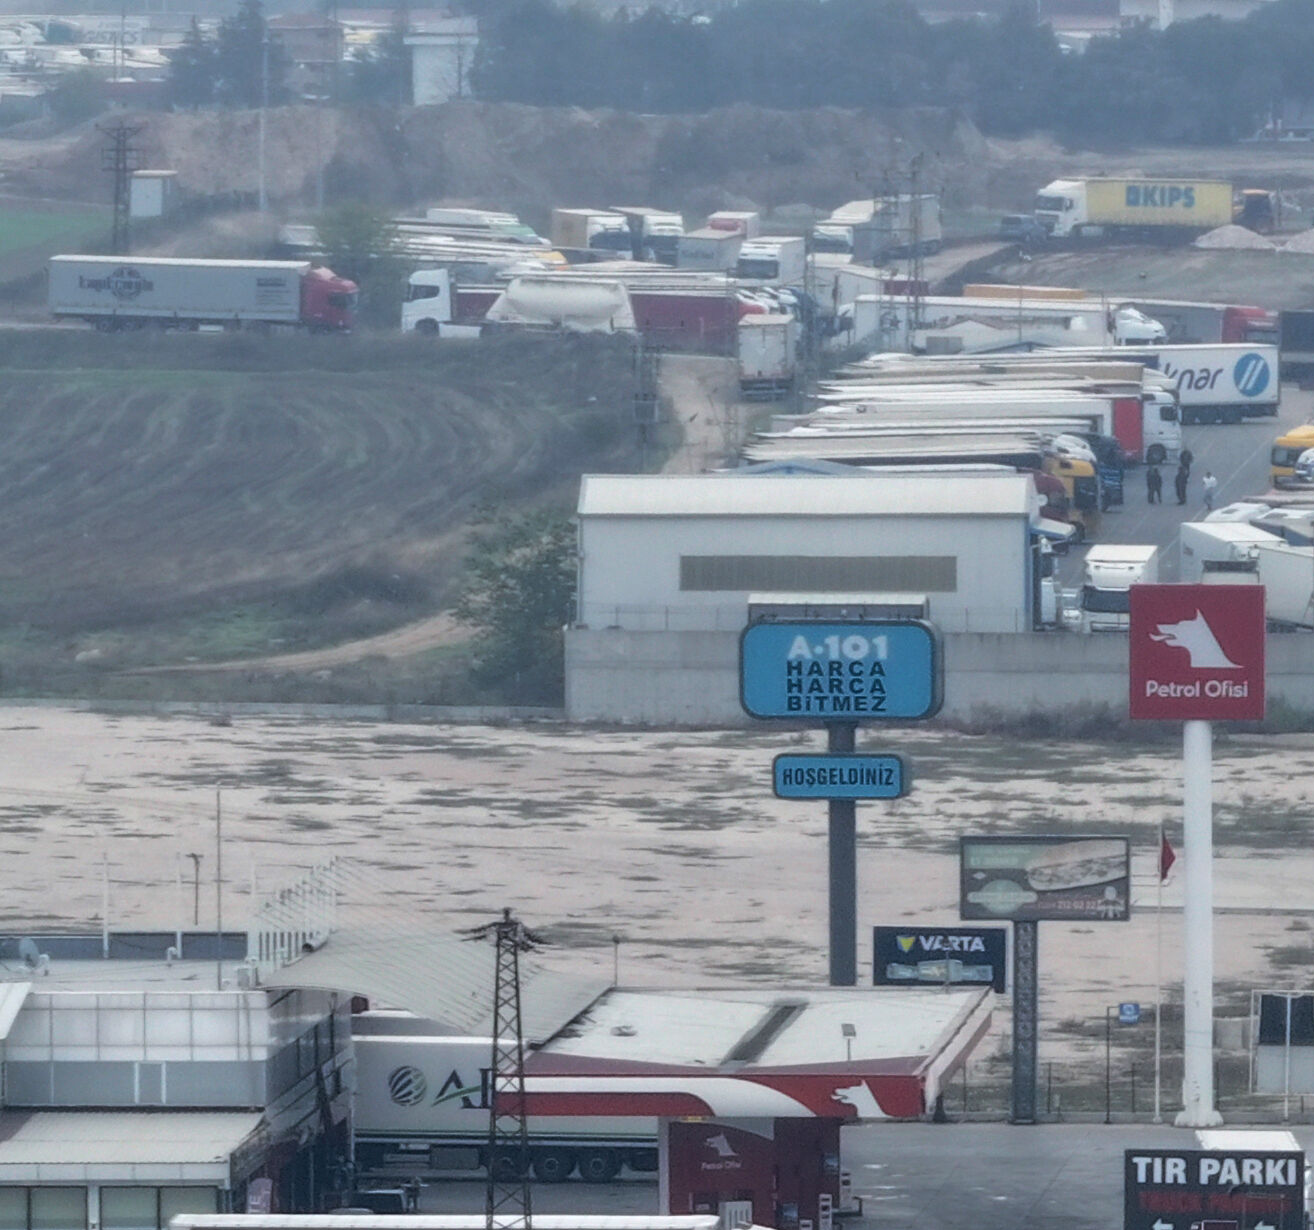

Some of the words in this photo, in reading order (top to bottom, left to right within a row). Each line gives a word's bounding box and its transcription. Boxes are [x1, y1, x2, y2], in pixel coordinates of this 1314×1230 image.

[786, 661, 887, 677] HARCA
[786, 678, 887, 694] HARCA
[1146, 680, 1200, 697] Petrol
[1205, 680, 1248, 697] Ofisi
[783, 764, 895, 788] HOŞGELDİNİZ
[919, 936, 985, 952] VARTA
[1132, 1156, 1187, 1185] TIR
[1200, 1157, 1297, 1186] PARKI
